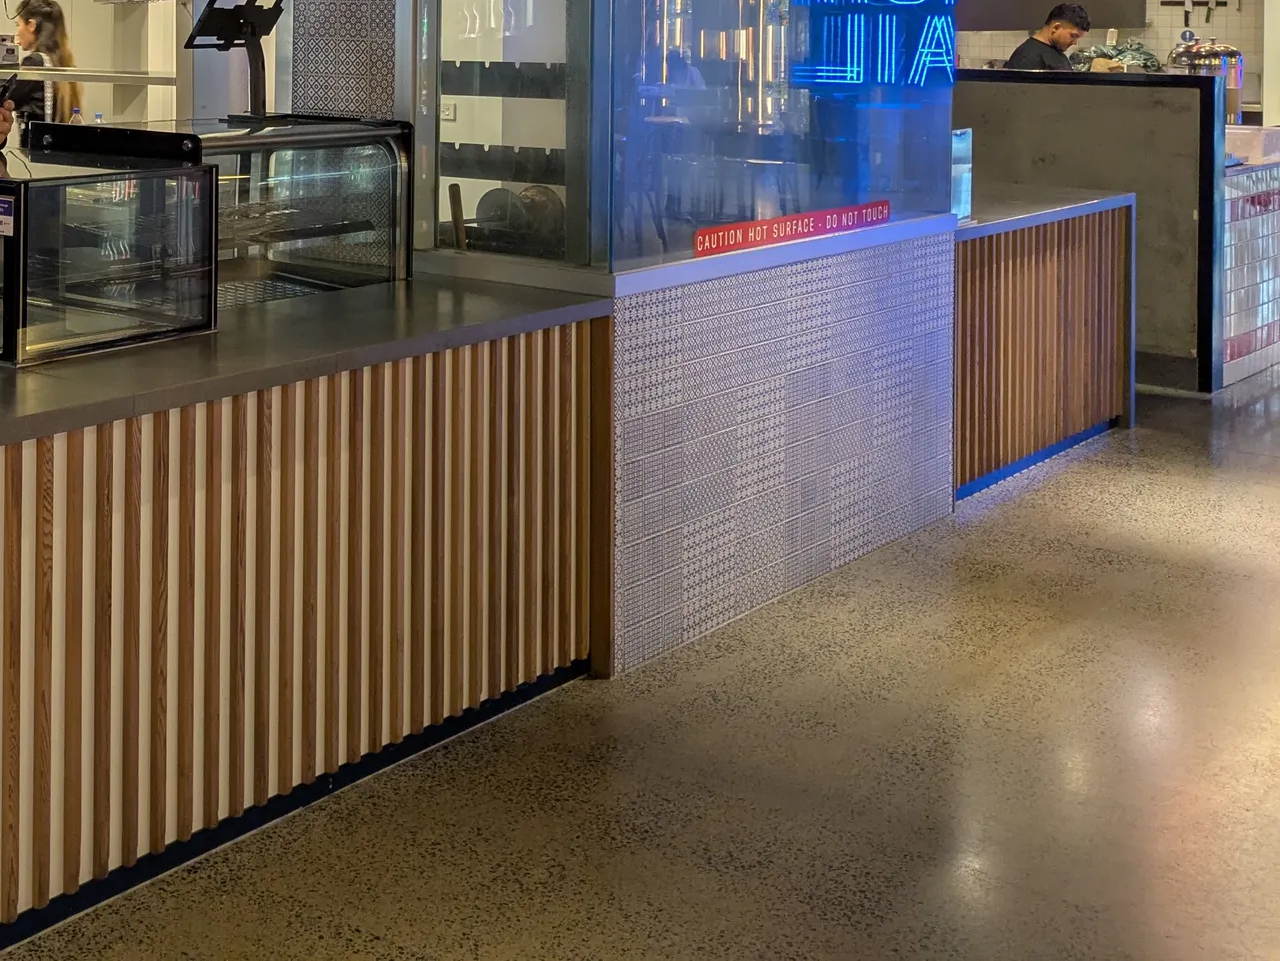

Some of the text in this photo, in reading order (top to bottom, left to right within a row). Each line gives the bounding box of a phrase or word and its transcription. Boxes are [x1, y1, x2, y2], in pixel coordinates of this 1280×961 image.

[697, 230, 742, 251] CAUTION
[748, 225, 768, 240] HOT
[772, 217, 814, 237] SURFACE
[826, 215, 838, 229] DO
[842, 211, 858, 226] NOT
[863, 205, 889, 223] TOUCH
